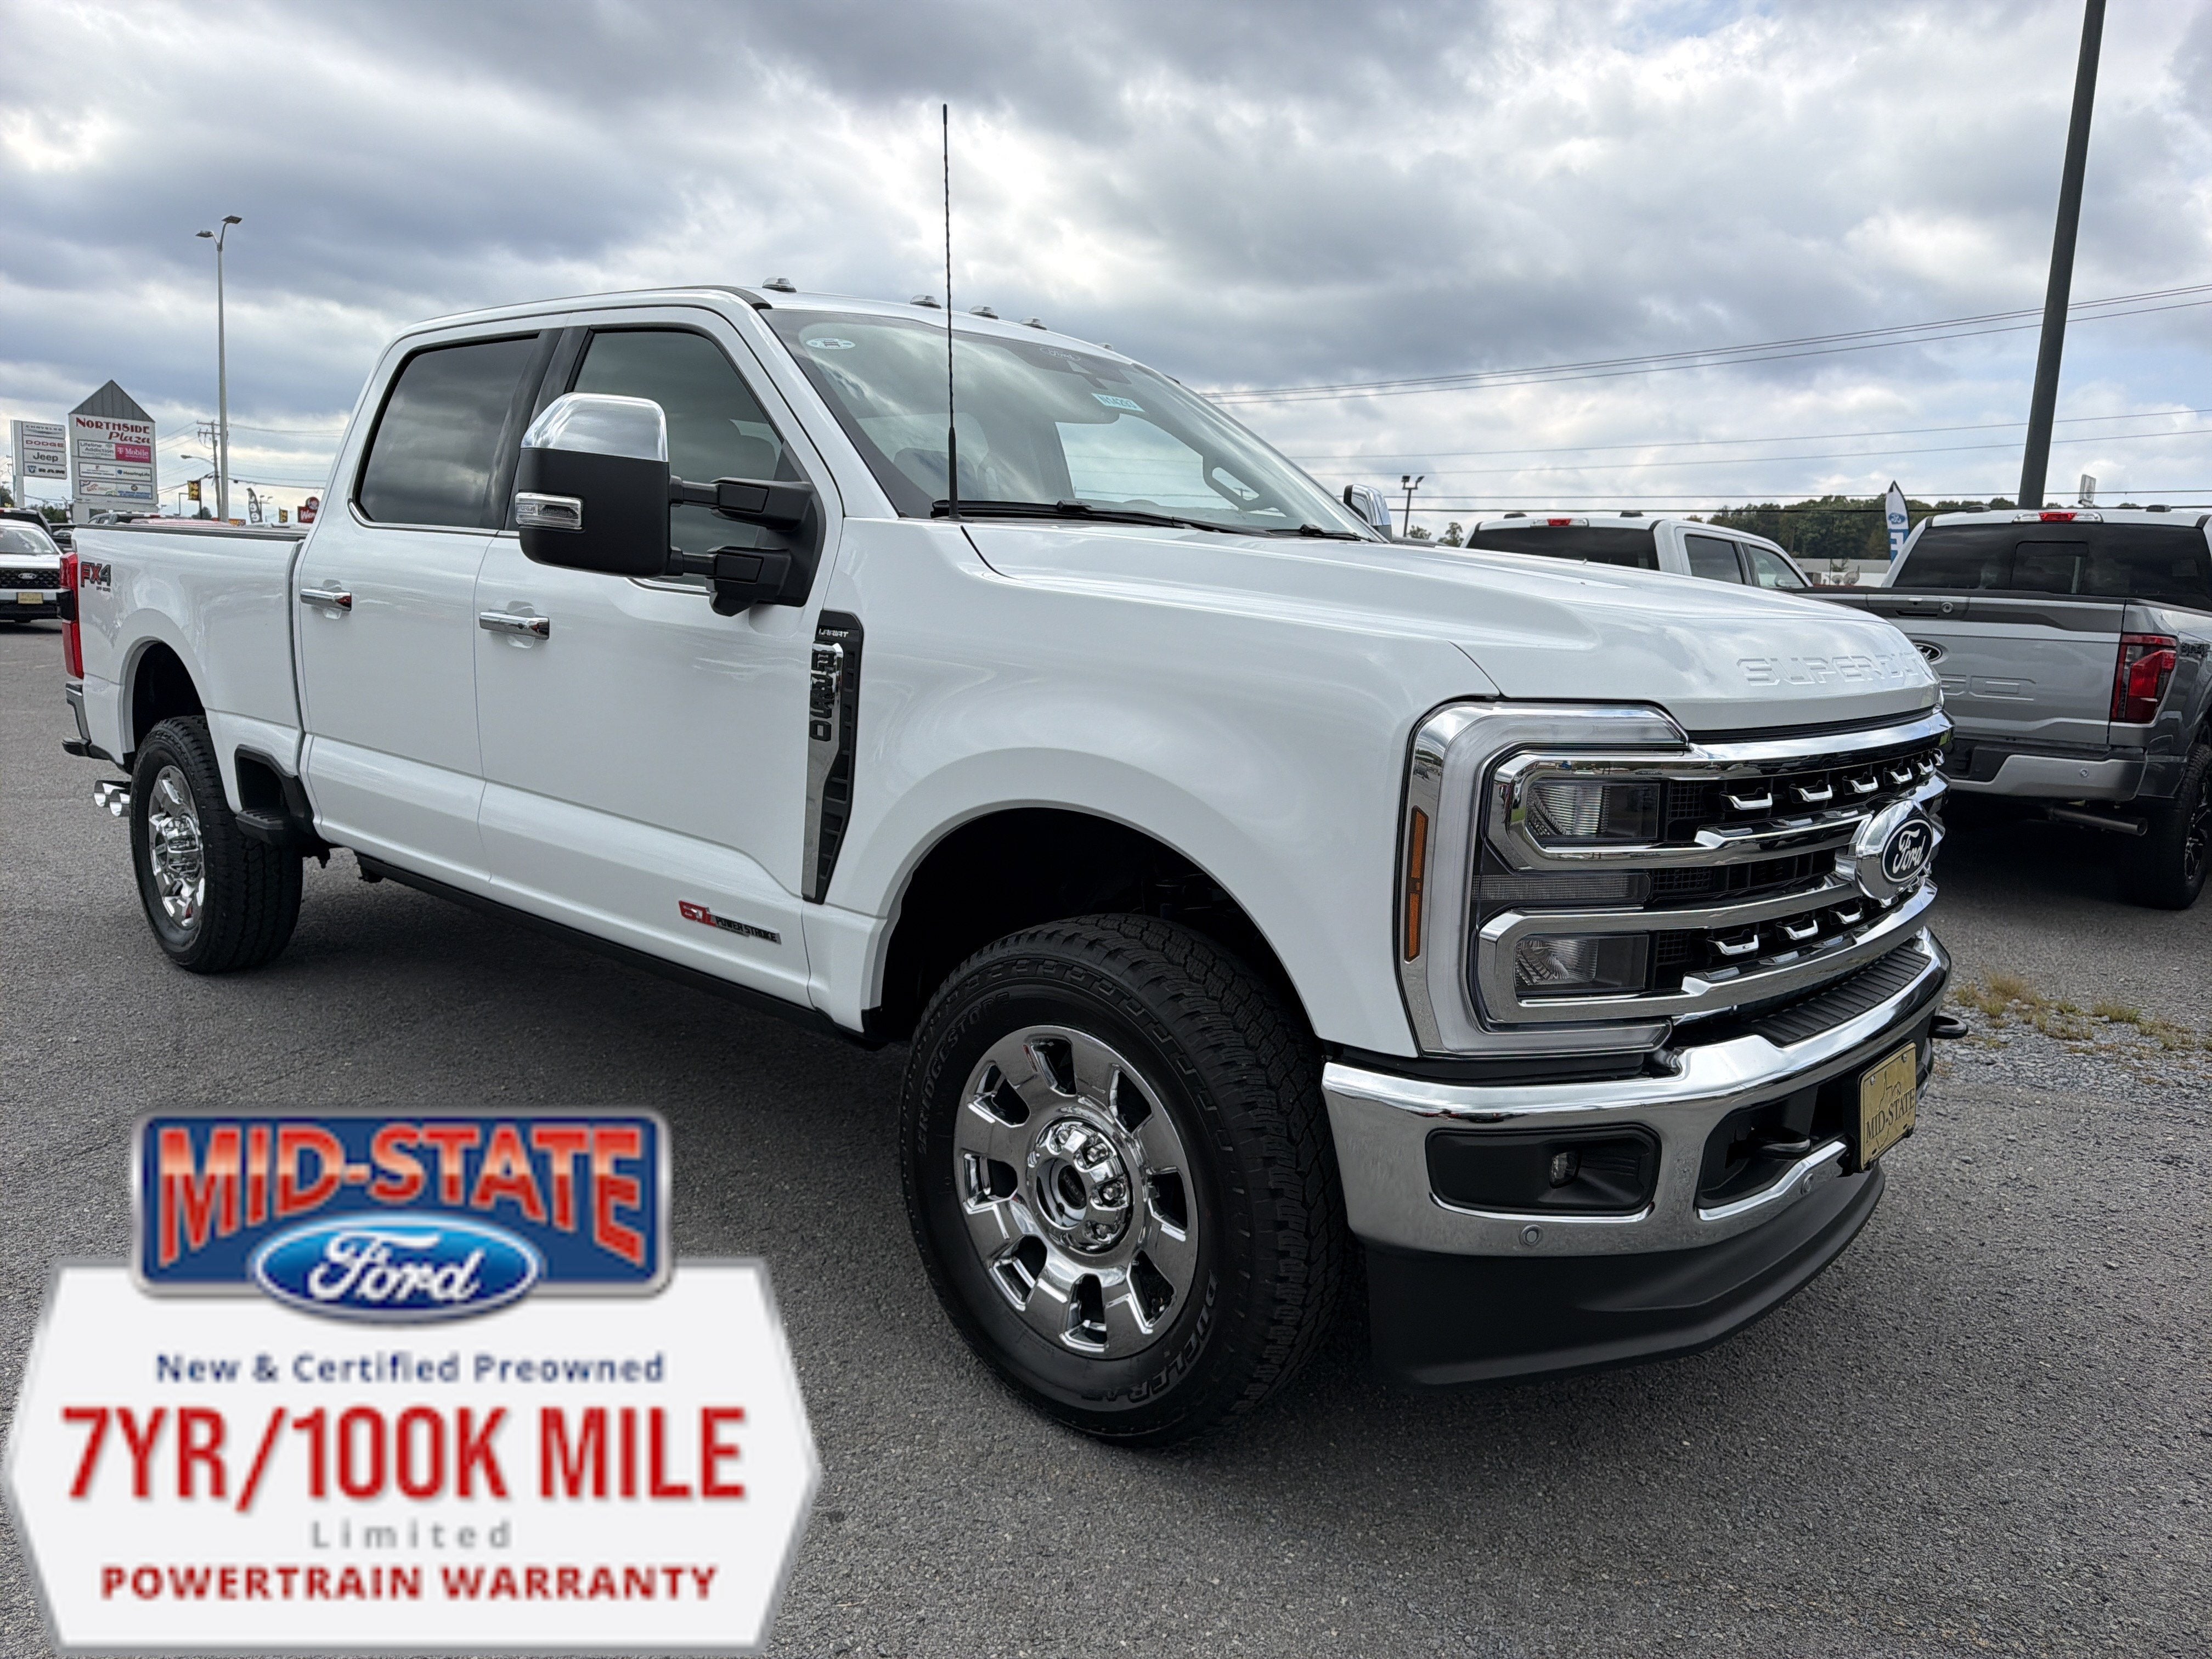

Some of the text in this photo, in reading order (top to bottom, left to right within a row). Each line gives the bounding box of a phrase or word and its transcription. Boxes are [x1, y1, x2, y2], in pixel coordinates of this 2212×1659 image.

[76, 417, 150, 435] NORTHSIDE
[25, 439, 64, 448] DODGE
[108, 431, 150, 444] Plaza
[33, 452, 59, 462] Jeep
[81, 561, 111, 588] FX4
[818, 628, 849, 638] LARIAT
[1892, 828, 1926, 874] Ford
[1865, 1087, 1915, 1143] MID-STATE
